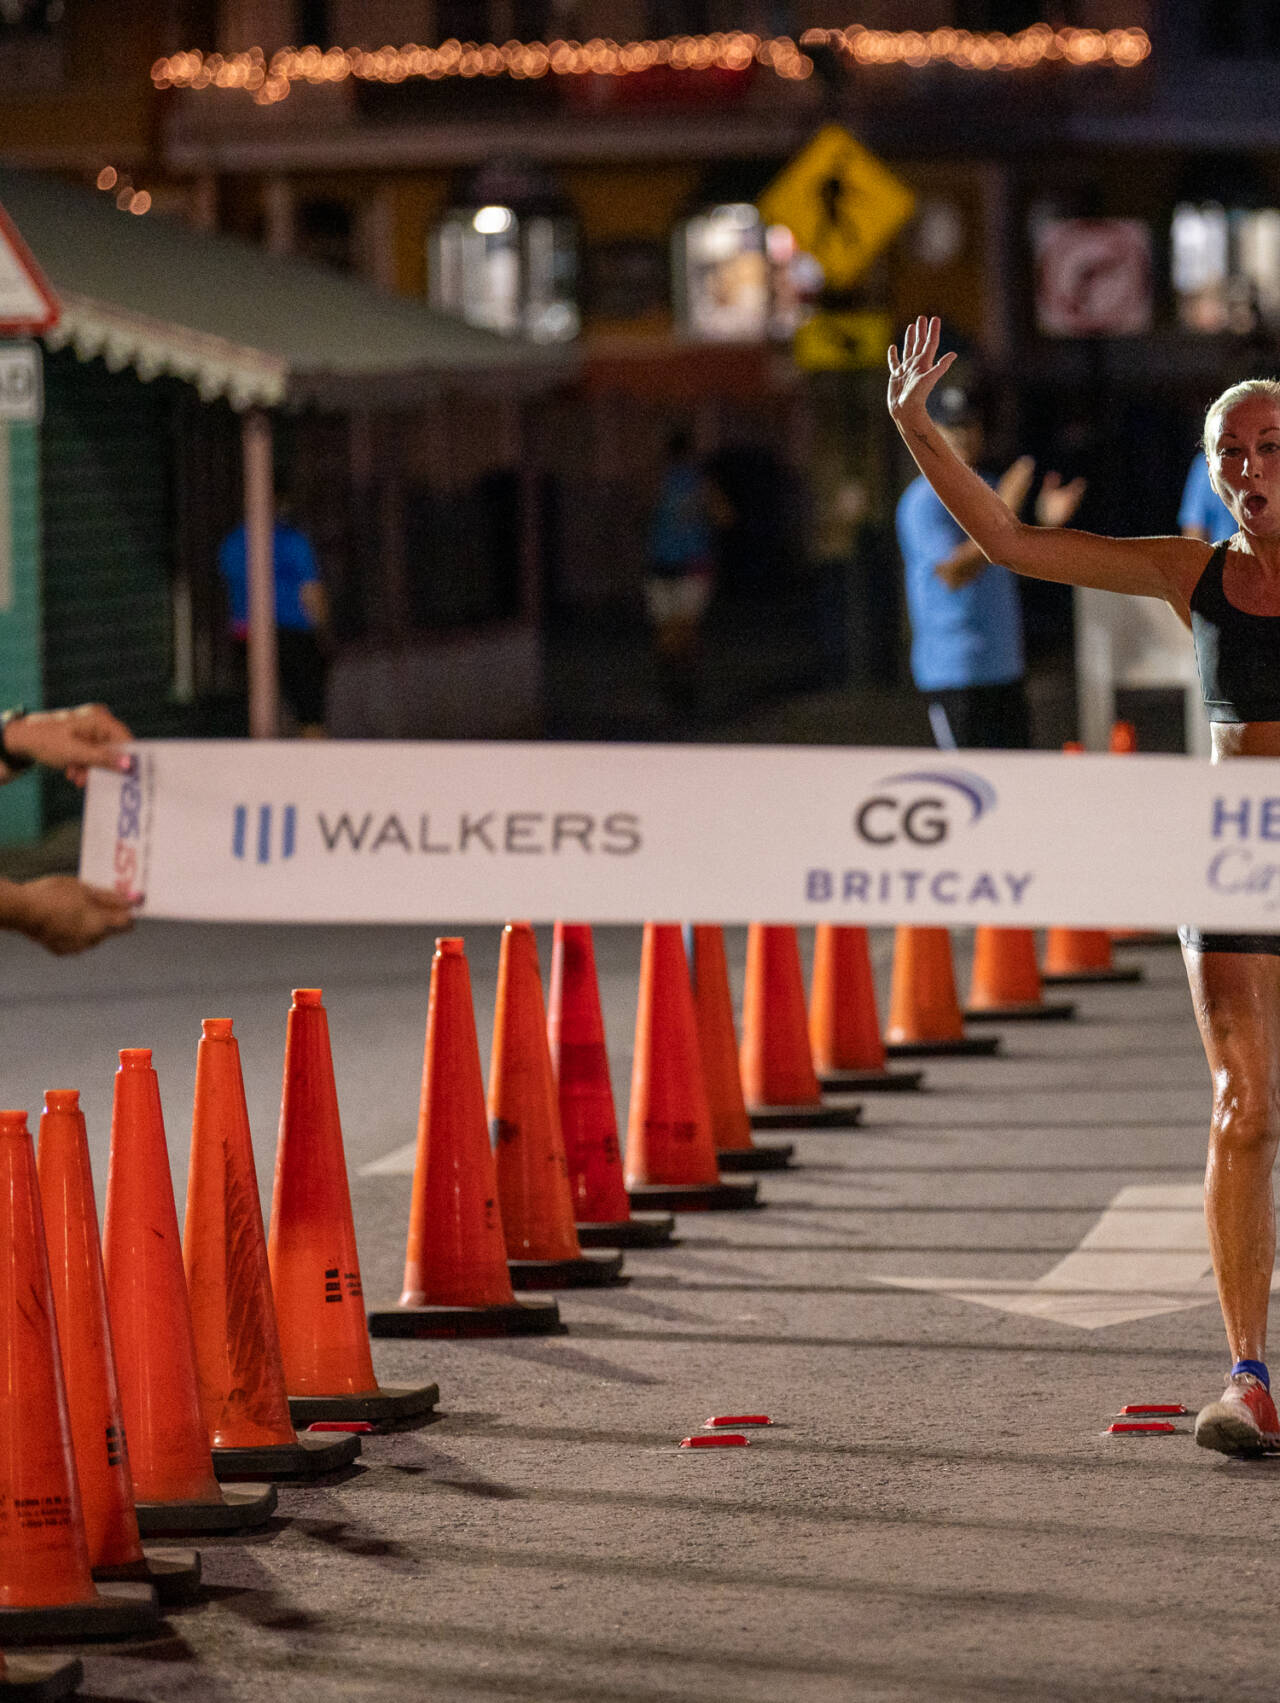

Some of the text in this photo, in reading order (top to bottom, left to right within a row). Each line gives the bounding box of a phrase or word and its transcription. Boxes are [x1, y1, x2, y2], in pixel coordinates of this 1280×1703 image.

[316, 811, 644, 856] WALKERS
[854, 796, 949, 846] CG
[804, 868, 1032, 904] BRITCAY
